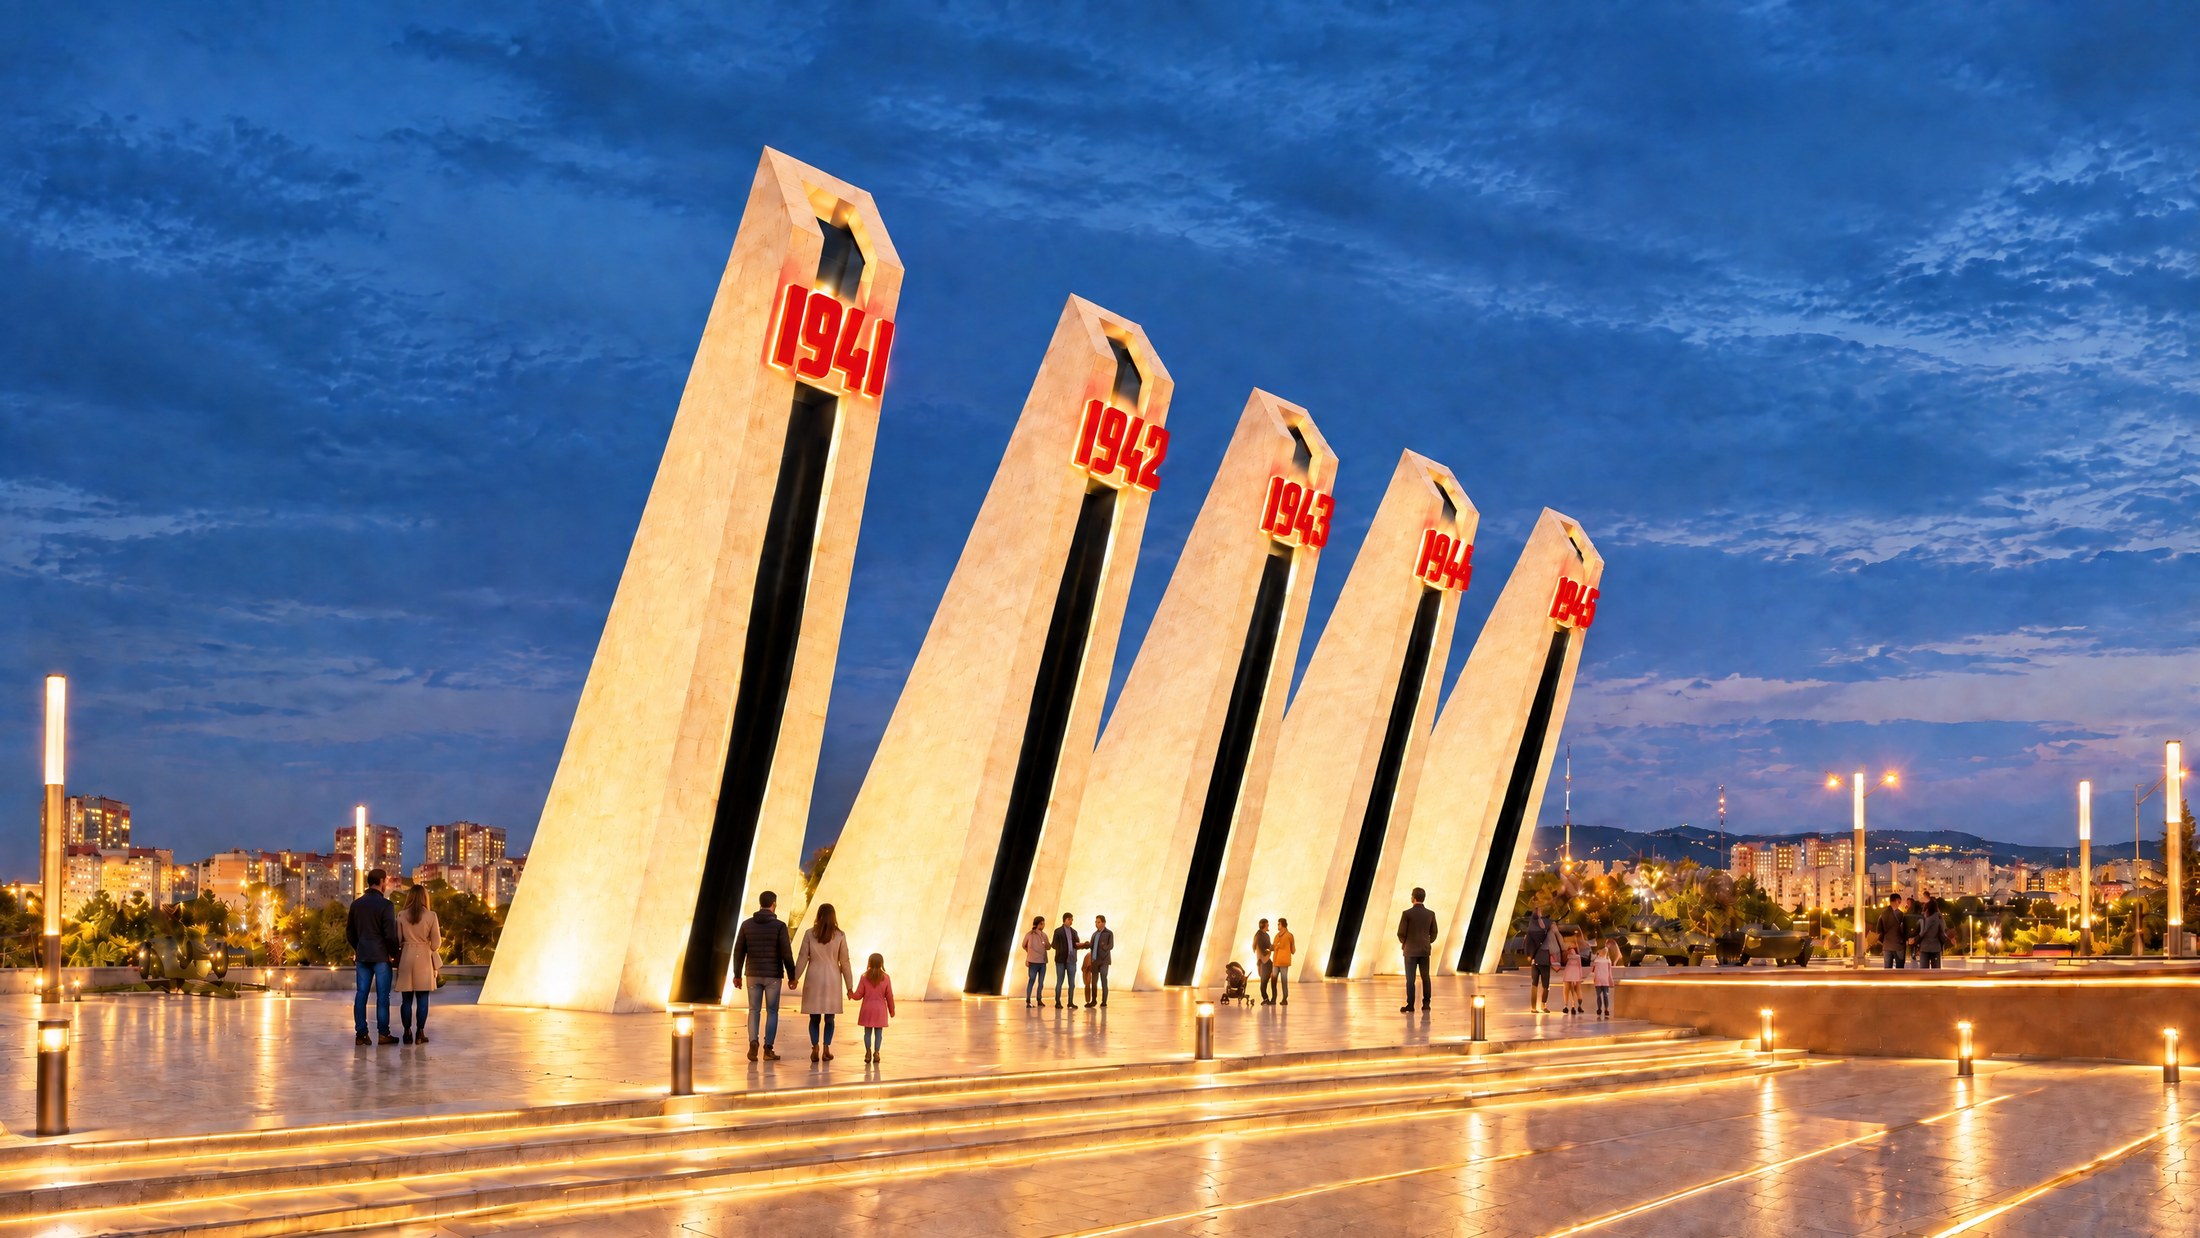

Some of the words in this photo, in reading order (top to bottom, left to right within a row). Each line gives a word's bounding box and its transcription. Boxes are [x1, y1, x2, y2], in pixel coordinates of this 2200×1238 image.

[771, 284, 895, 396] 1941
[1074, 399, 1171, 492] 1942
[1261, 476, 1336, 549] 1943
[1415, 529, 1475, 592] 1944
[1548, 576, 1601, 629] 1945
